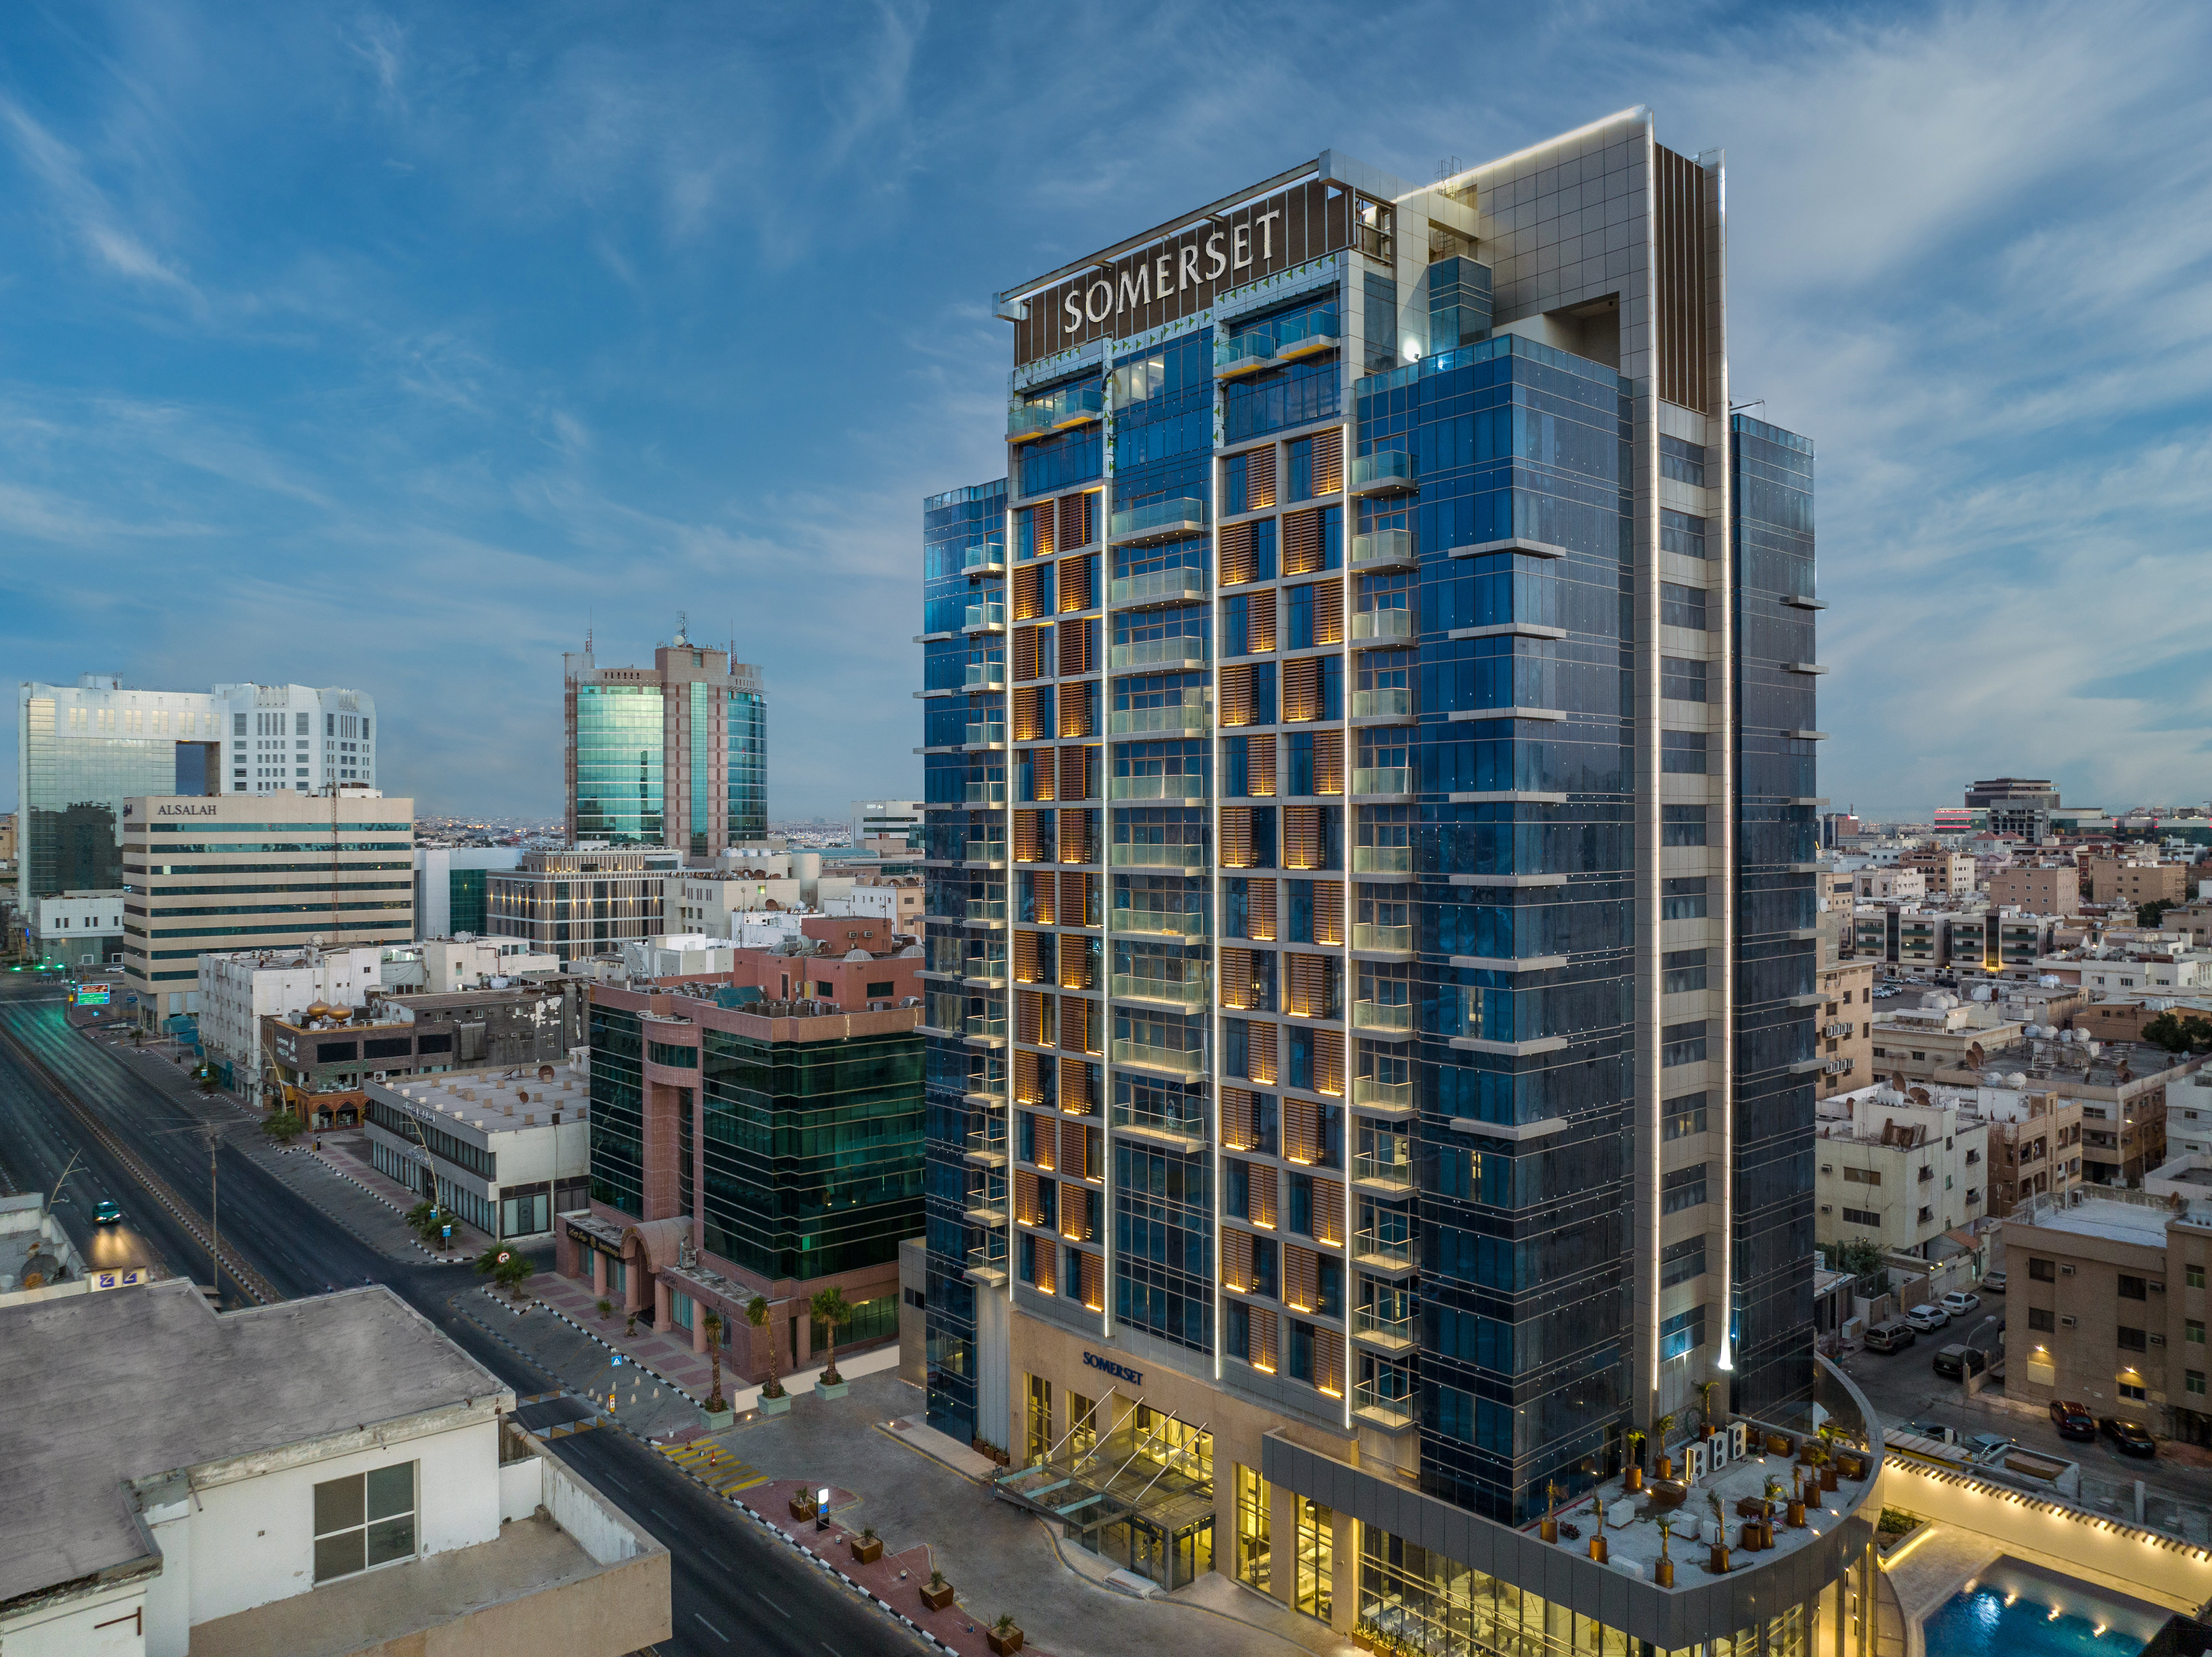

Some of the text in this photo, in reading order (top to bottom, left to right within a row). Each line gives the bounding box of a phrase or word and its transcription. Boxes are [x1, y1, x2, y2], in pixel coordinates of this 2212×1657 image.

[1065, 209, 1280, 333] SOMERSET
[158, 805, 217, 815] ALSALAH
[1083, 1351, 1143, 1386] SOMERSET
